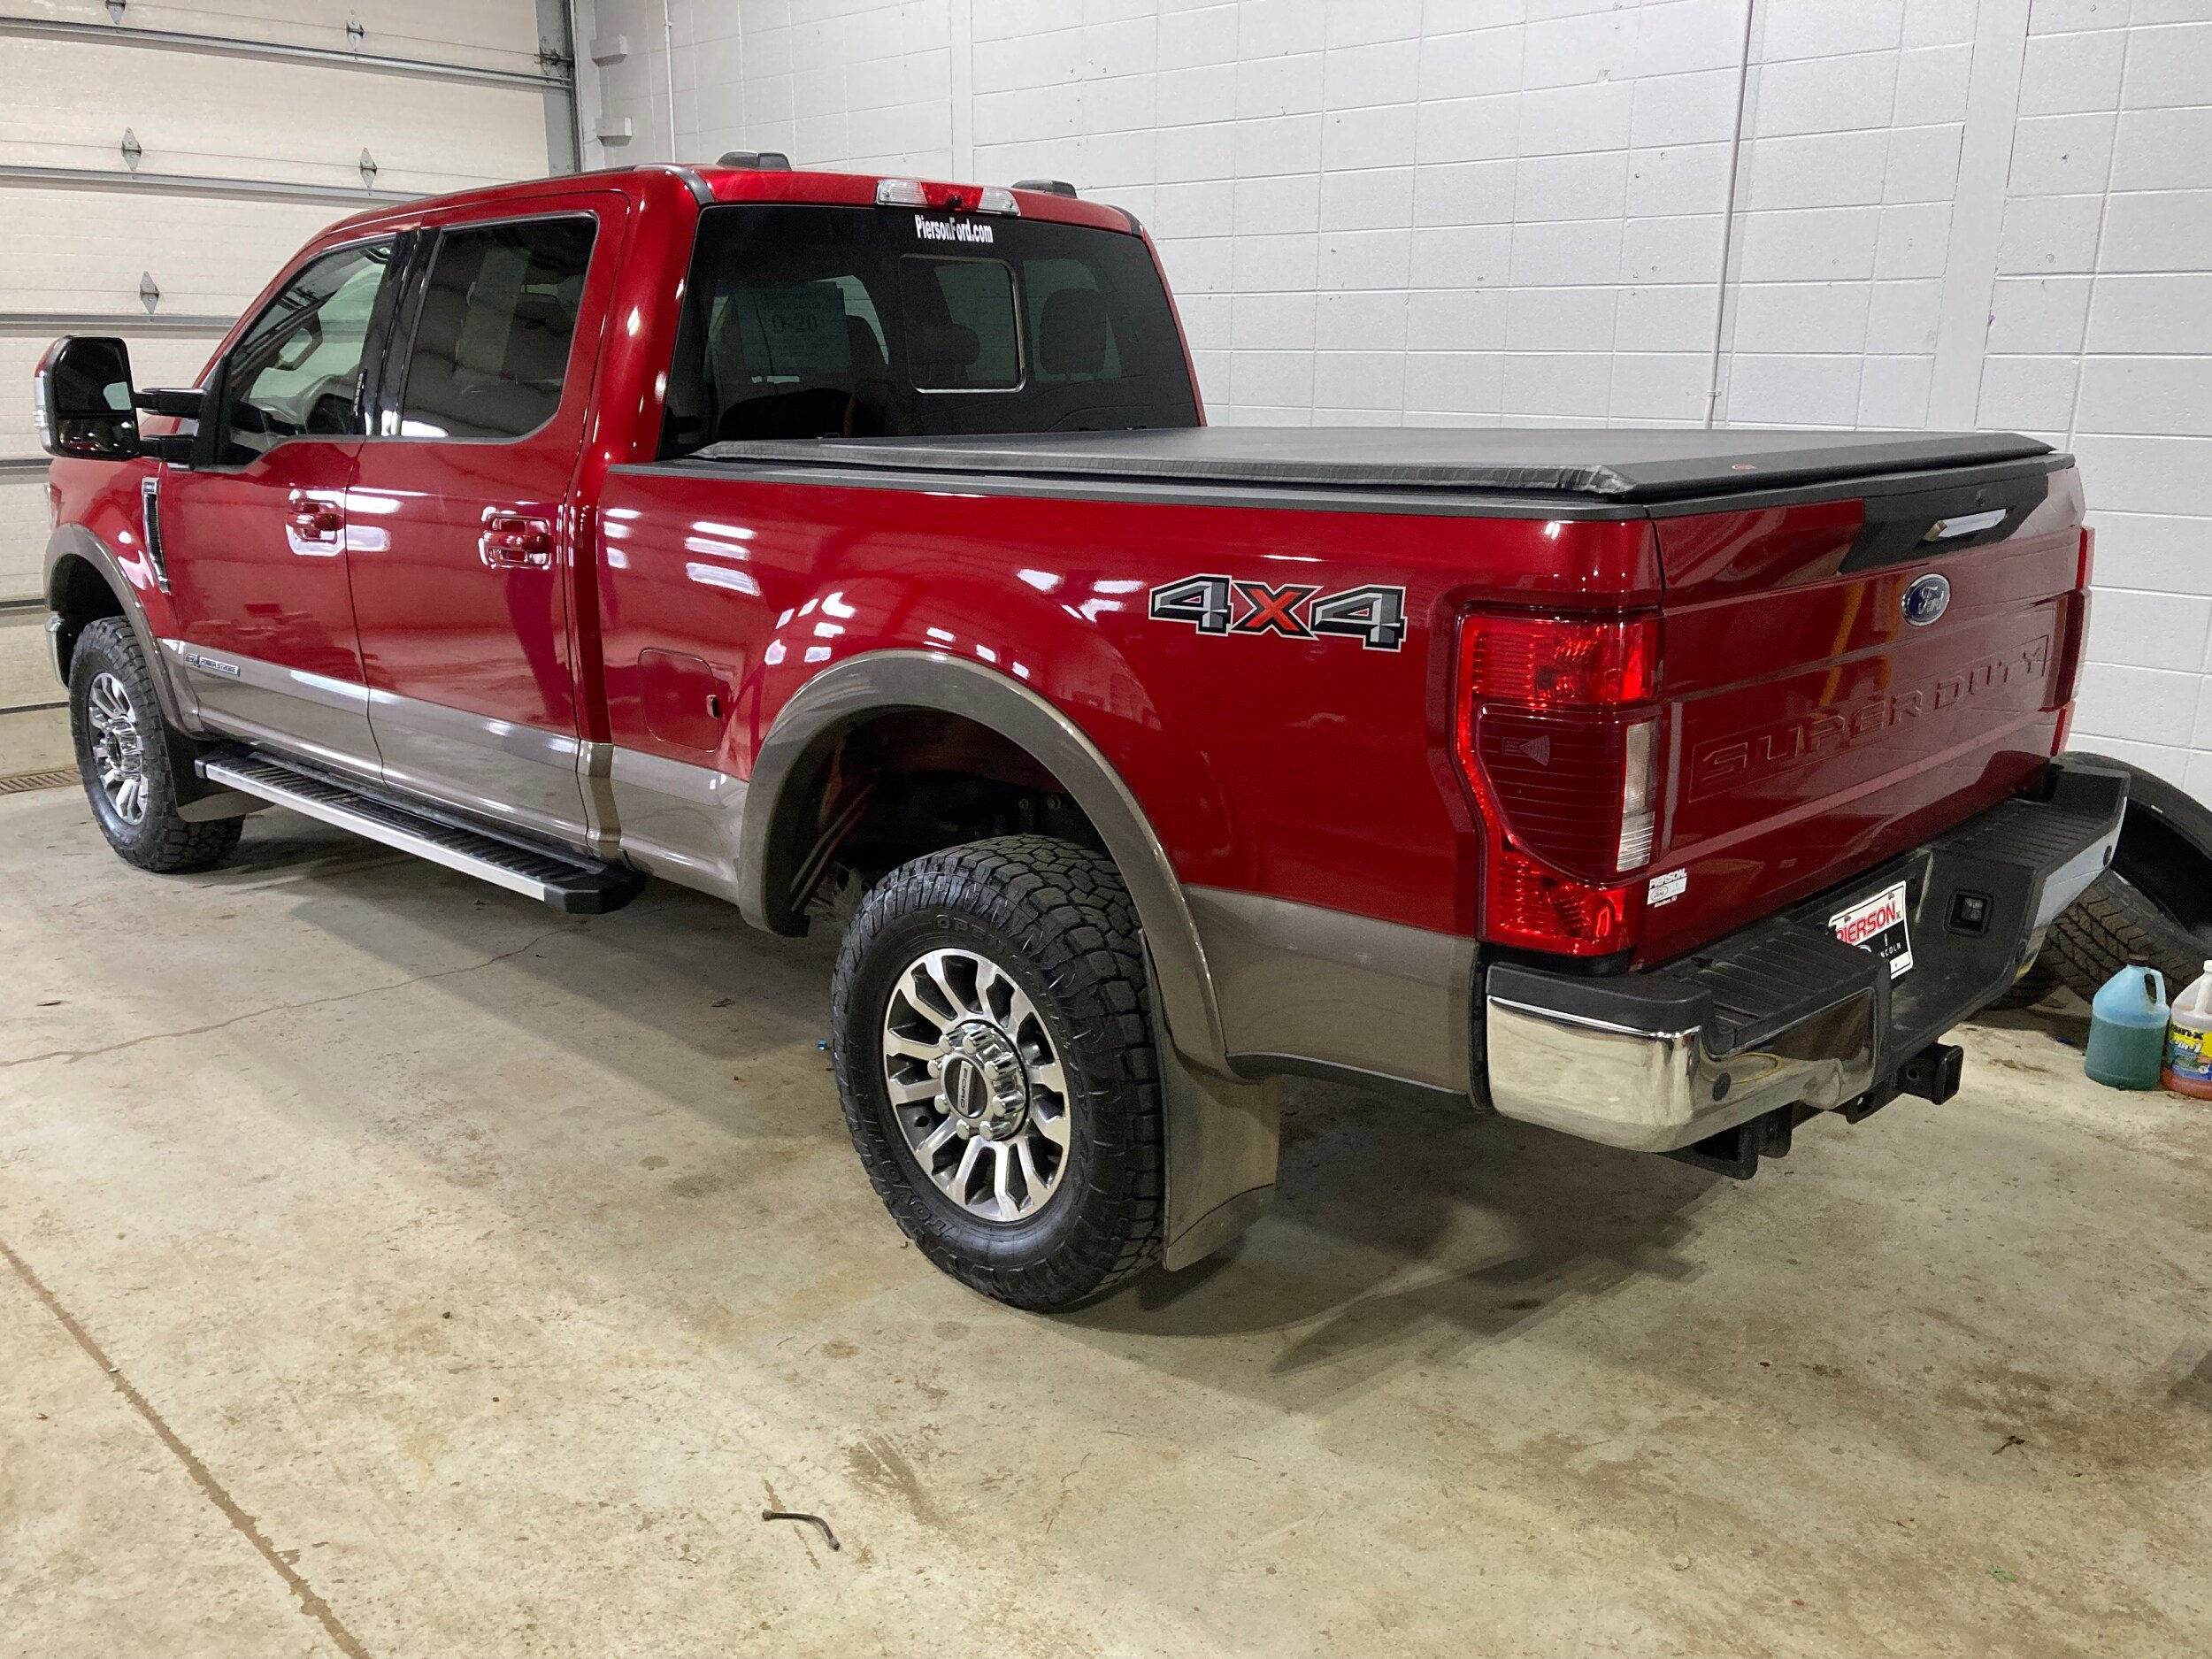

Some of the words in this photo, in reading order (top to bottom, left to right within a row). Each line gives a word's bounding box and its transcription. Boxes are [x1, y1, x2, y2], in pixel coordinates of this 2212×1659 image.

[915, 214, 994, 243] PiersonFord.com
[1148, 573, 1408, 653] 4X4
[1918, 586, 1944, 614] Ford
[1701, 689, 1924, 785] SUPER
[1934, 645, 2042, 710] DUTY
[1878, 942, 1901, 958] NCOLN
